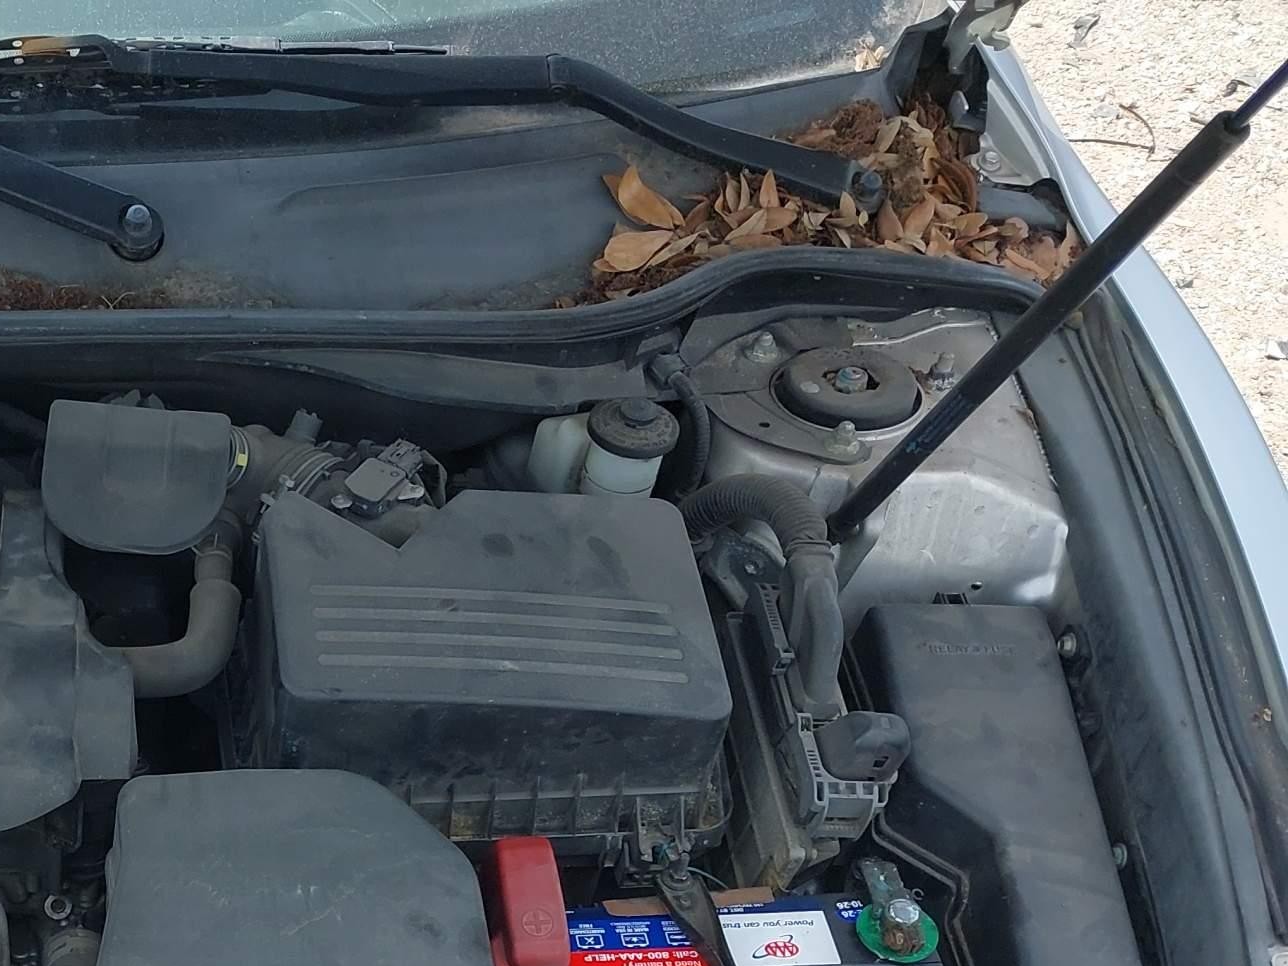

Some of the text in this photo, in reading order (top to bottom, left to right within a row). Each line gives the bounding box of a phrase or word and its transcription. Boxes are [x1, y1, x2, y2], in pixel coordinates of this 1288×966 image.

[836, 900, 863, 909] 10-26
[763, 919, 781, 928] you
[784, 919, 814, 928] Power
[766, 941, 799, 957] AAA
[584, 952, 669, 962] 800-AAA-HELP
